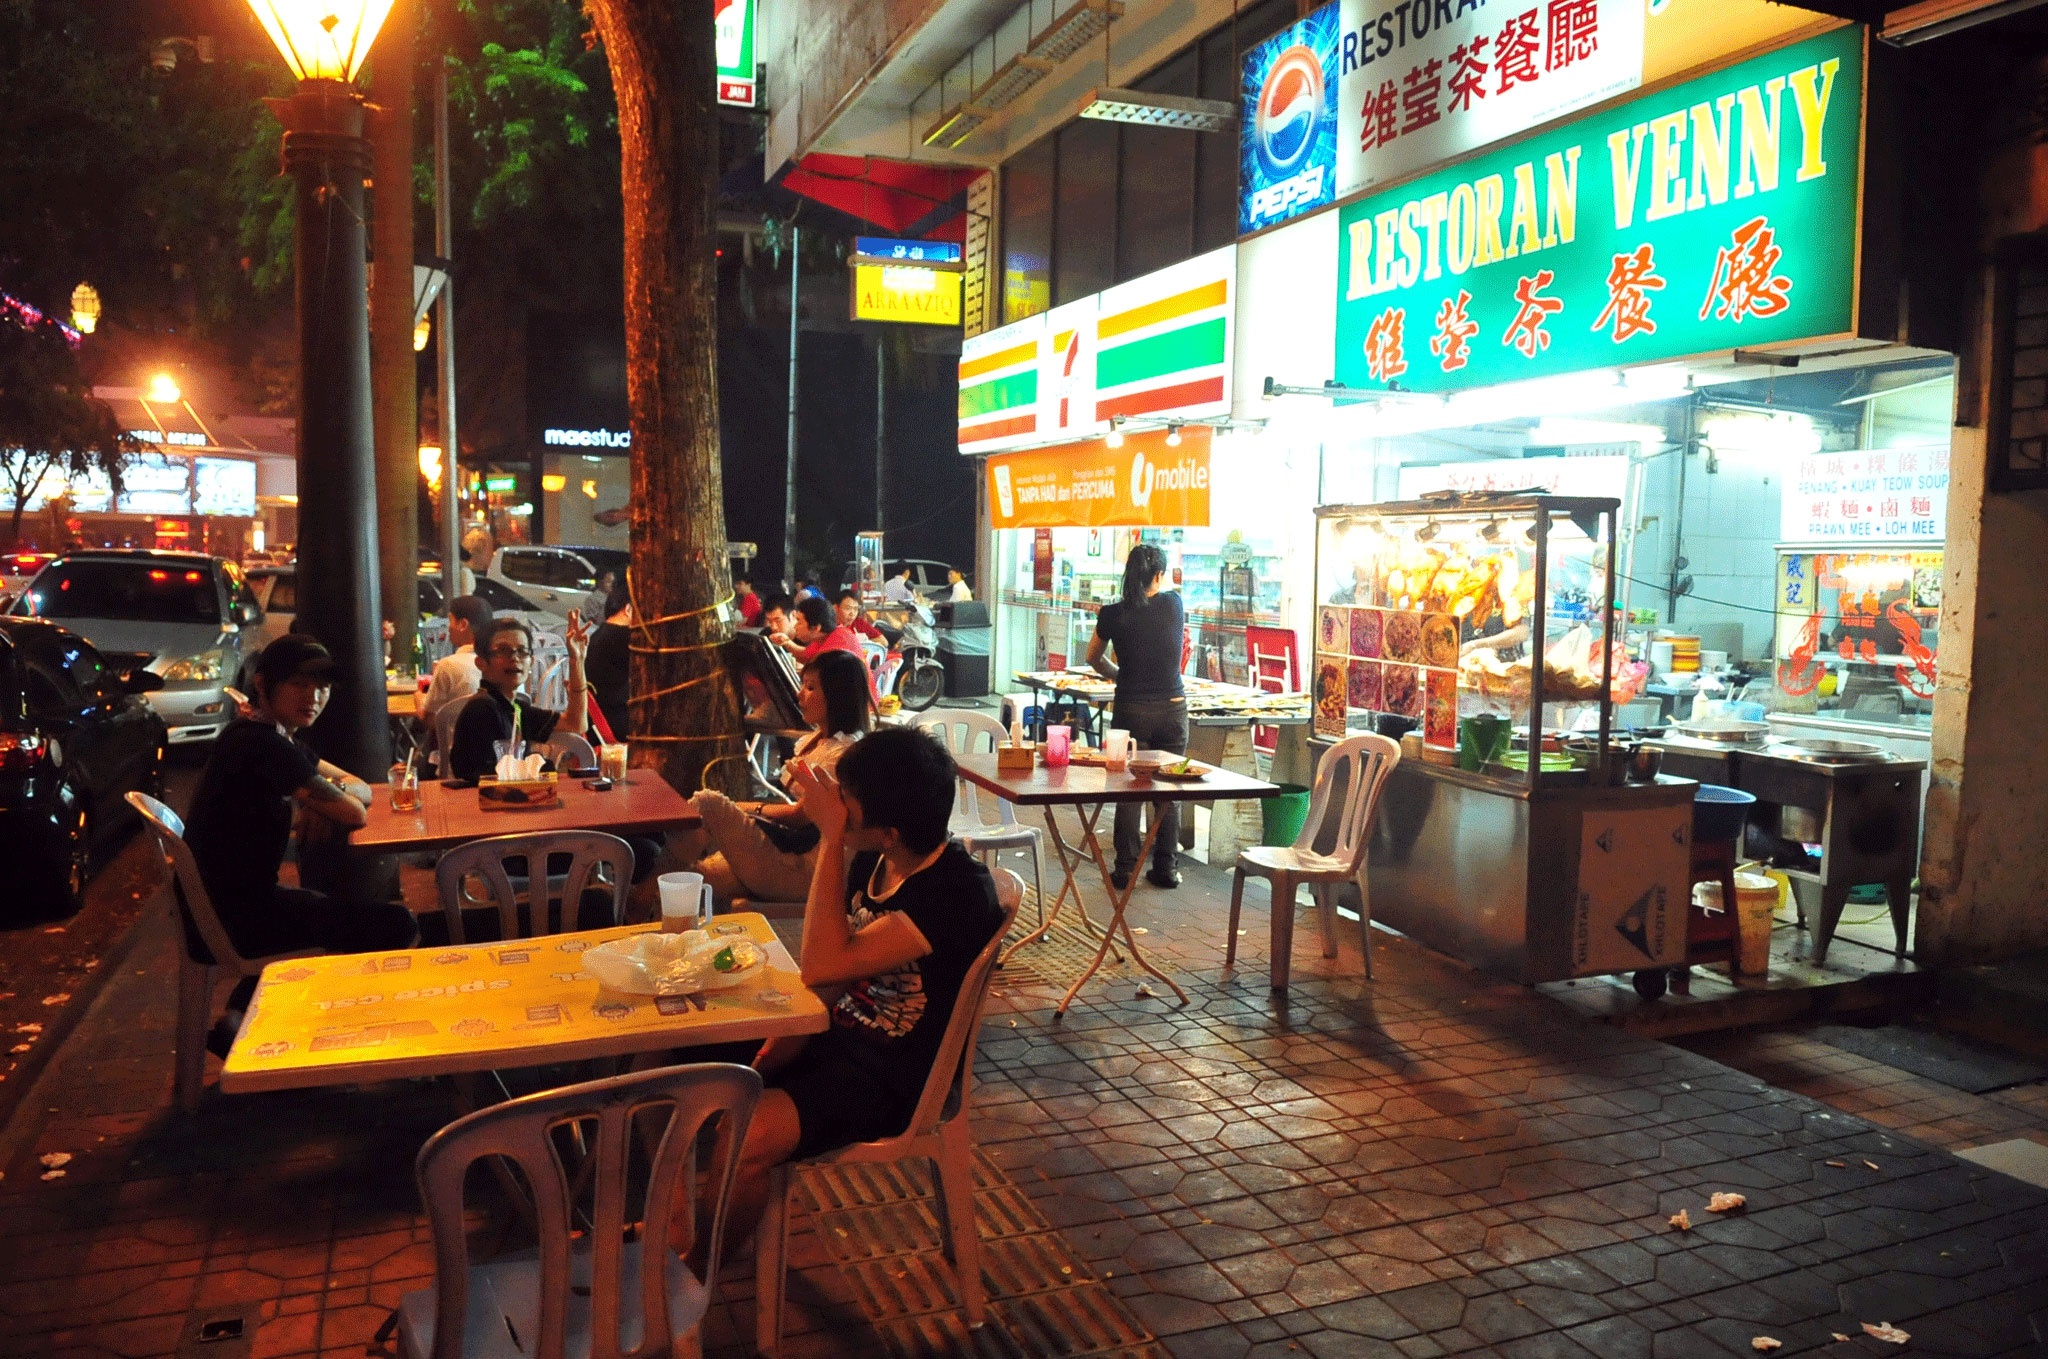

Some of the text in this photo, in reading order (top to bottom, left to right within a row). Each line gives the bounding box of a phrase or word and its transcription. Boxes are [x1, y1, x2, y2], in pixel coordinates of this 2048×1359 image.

[1343, 0, 1486, 76] RESTORA
[1250, 164, 1324, 223] PEPSI
[1346, 56, 1840, 302] RESTORAN VENNY
[1072, 478, 1116, 501] PERCUMA
[1155, 458, 1209, 491] mobile
[1851, 478, 1877, 492] KUAY
[1882, 476, 1913, 491] TEOW
[1918, 474, 1949, 490] SOUP
[1809, 520, 1935, 536] PRAWN MEE LOH MEE
